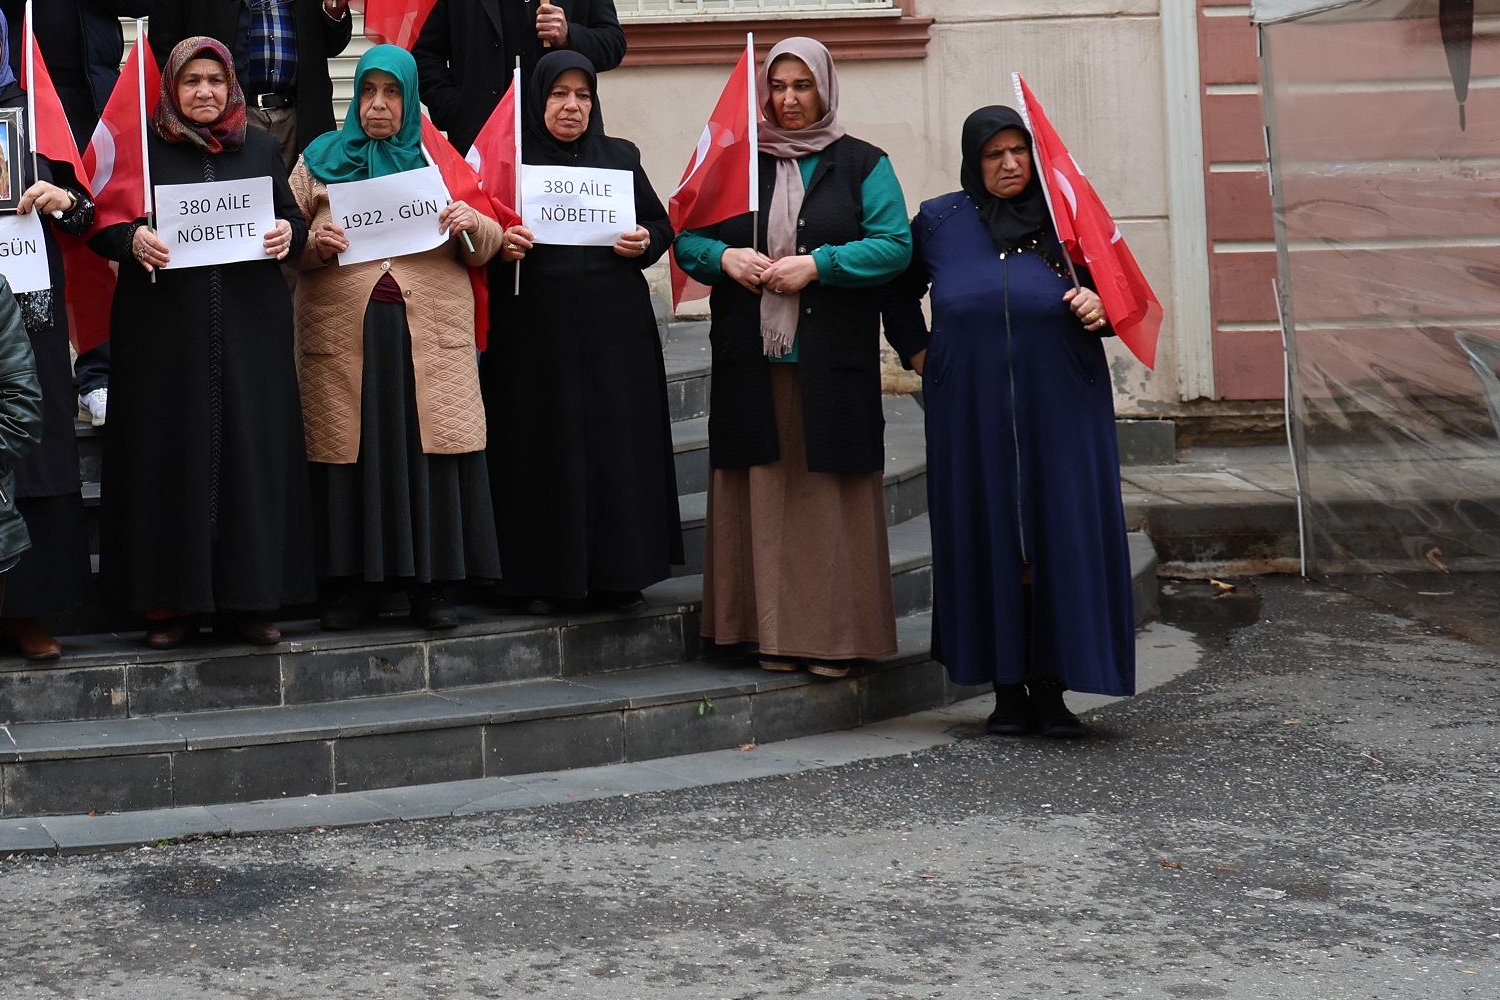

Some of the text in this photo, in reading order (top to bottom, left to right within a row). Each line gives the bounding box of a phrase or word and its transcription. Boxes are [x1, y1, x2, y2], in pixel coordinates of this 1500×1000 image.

[543, 178, 612, 198] 380 AİLE
[179, 193, 251, 216] 380 AİLE
[398, 199, 439, 219] GÜN
[541, 204, 617, 224] NÖBETTE
[177, 222, 257, 244] NÖBETTE
